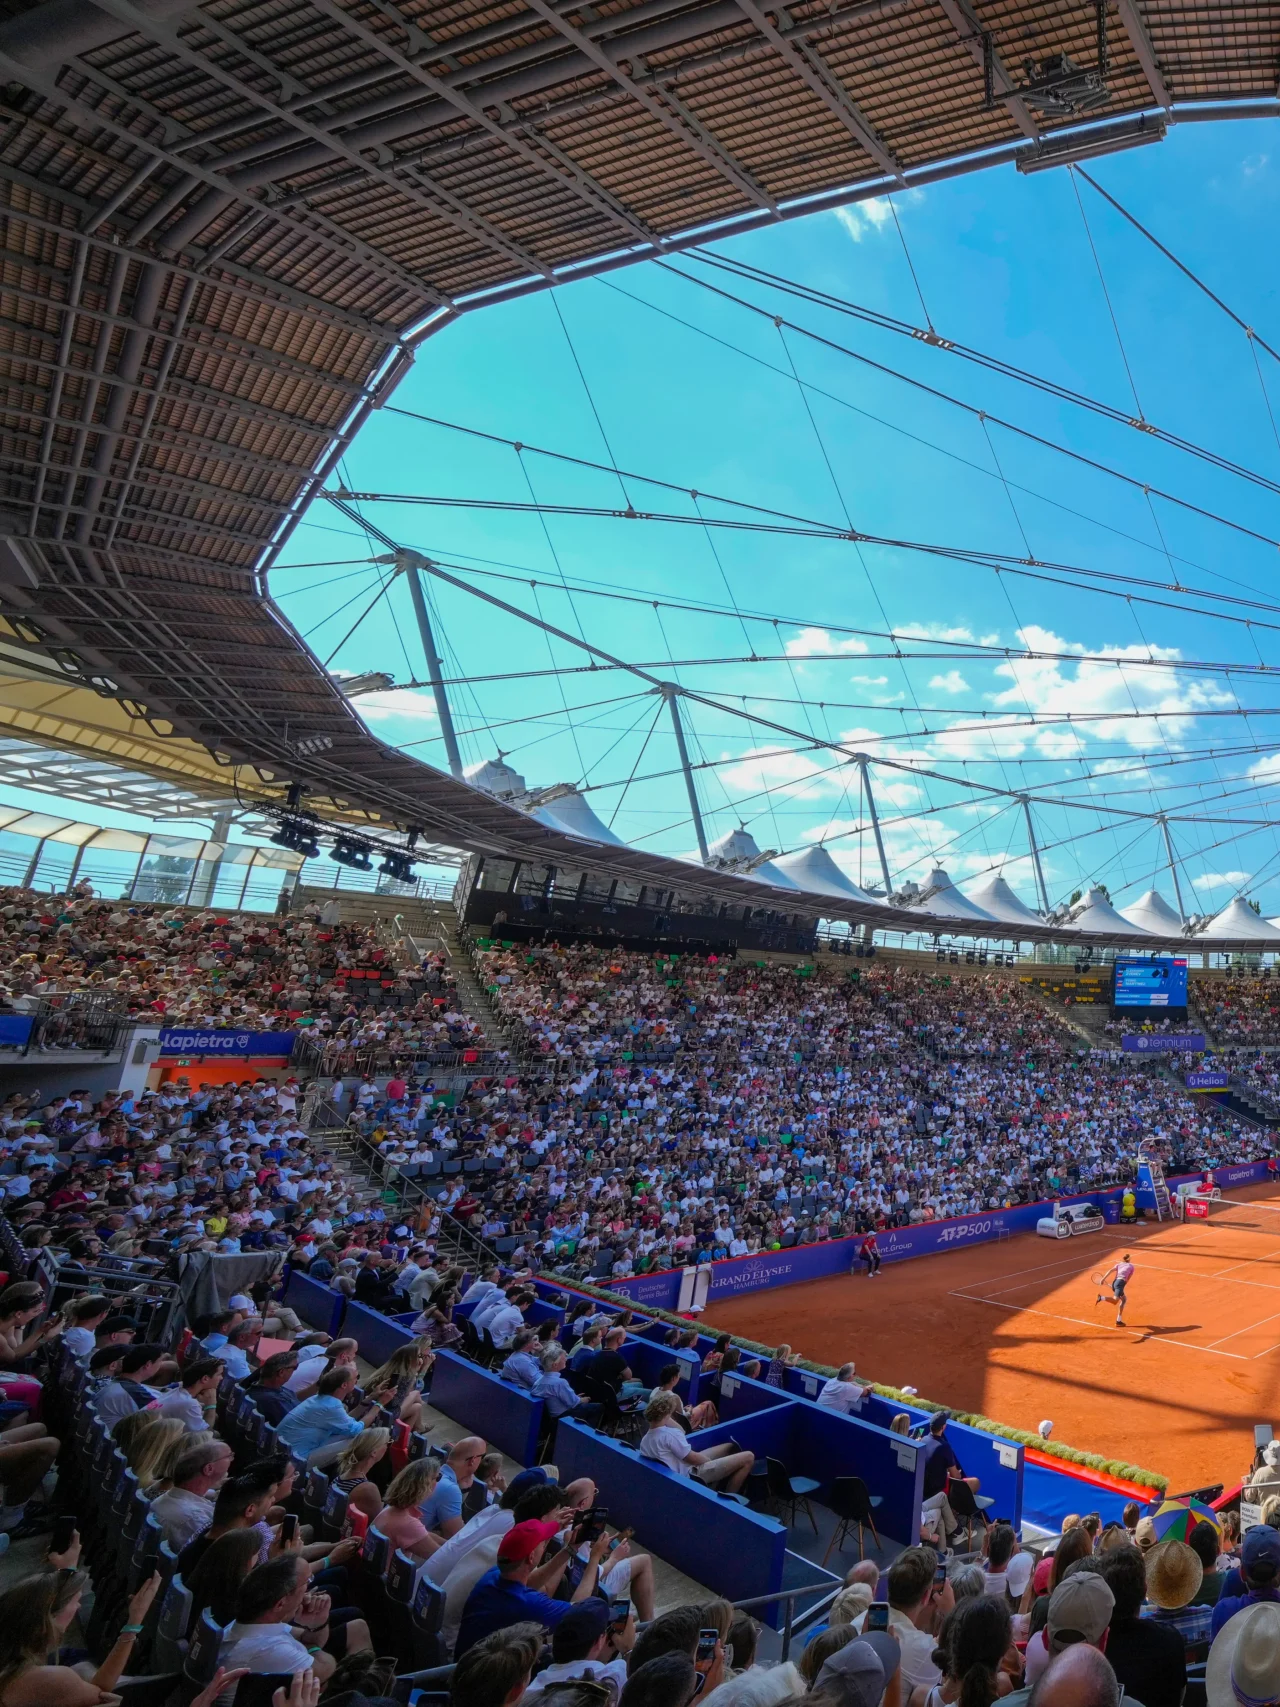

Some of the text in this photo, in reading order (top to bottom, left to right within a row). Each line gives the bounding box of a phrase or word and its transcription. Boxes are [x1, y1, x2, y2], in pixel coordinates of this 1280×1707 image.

[1150, 1038, 1192, 1048] tennium
[1197, 1076, 1224, 1085] Helios
[711, 1273, 751, 1288] GRAND
[733, 1277, 770, 1290] HAMBURG
[638, 1283, 666, 1294] Deutscher
[638, 1289, 670, 1301] Tennis Bund
[1241, 1512, 1258, 1520] Premium
